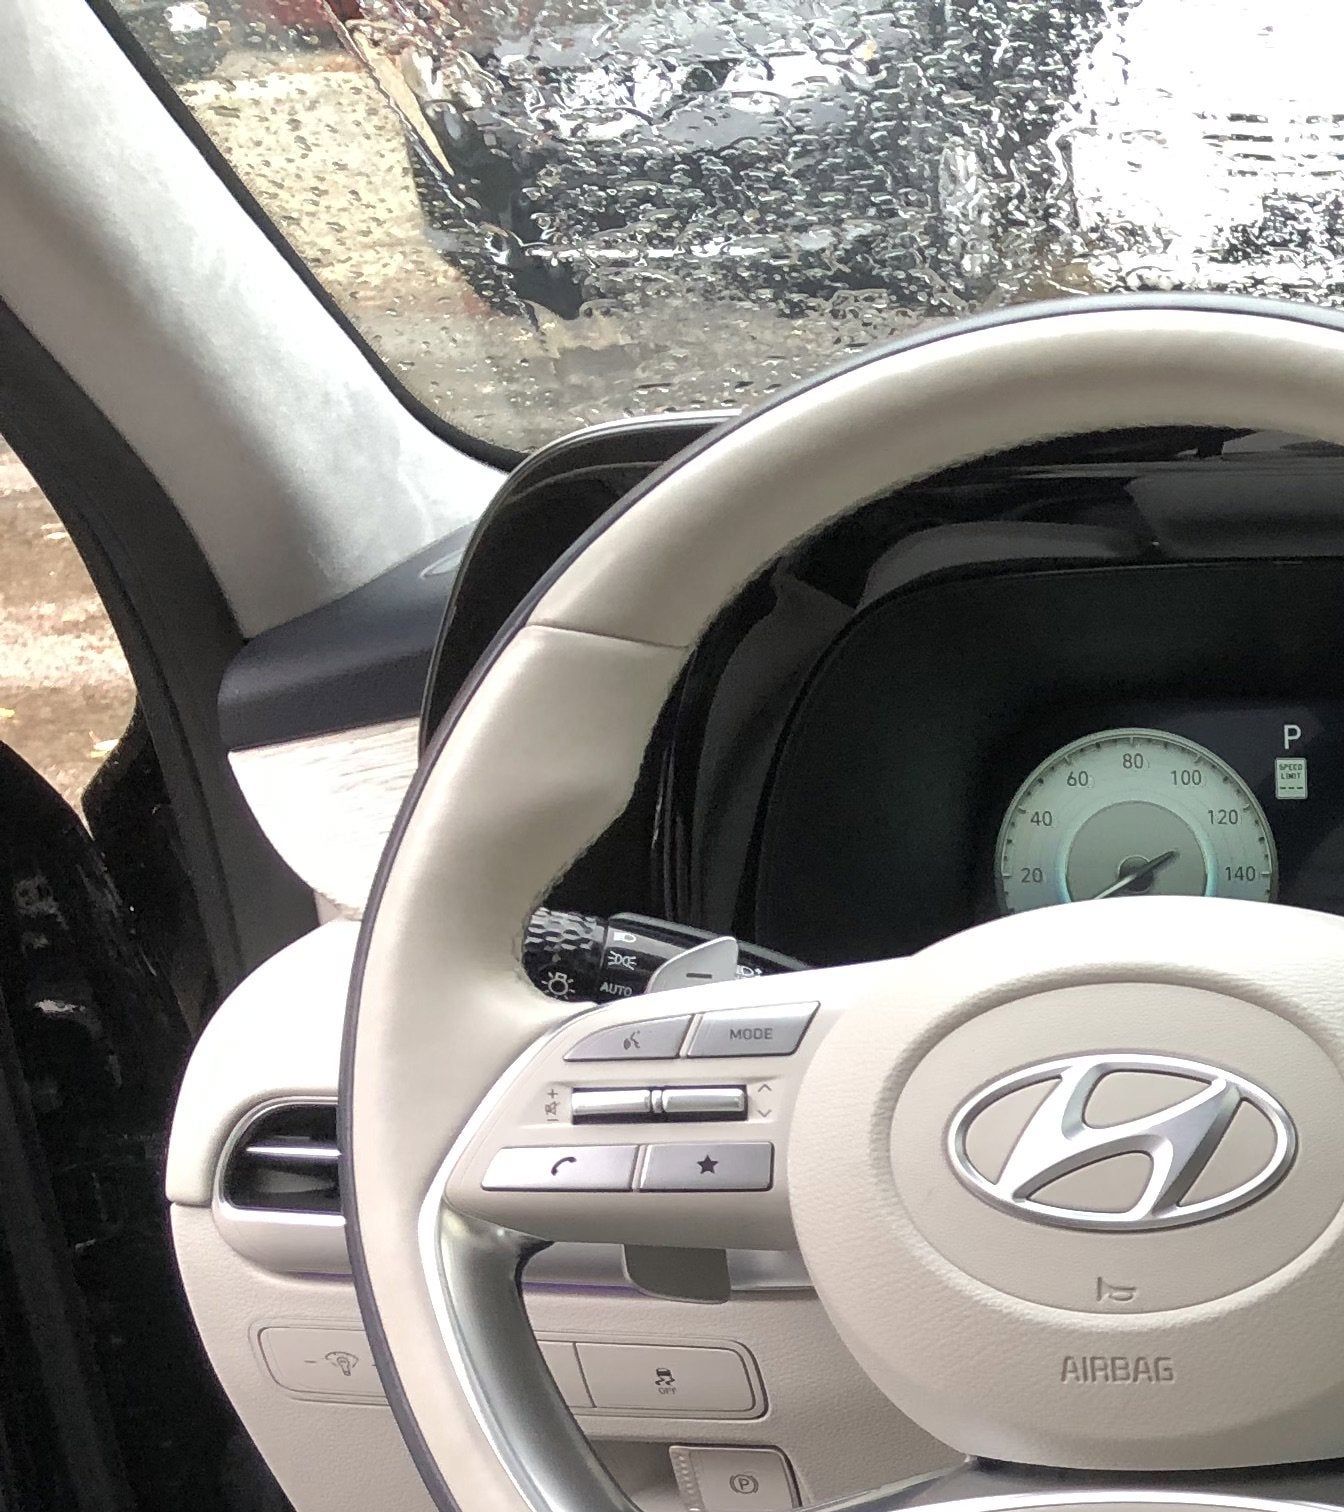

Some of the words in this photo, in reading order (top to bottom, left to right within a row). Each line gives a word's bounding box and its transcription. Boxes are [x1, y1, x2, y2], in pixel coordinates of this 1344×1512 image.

[1283, 724, 1302, 750] P
[1121, 753, 1145, 769] 80
[1066, 770, 1089, 787] 60
[1170, 769, 1202, 786] 100
[1030, 810, 1052, 827] 40
[1208, 809, 1239, 826] 120
[1020, 867, 1043, 883] 20
[1225, 866, 1256, 882] 140
[600, 981, 633, 997] AUTO
[729, 1027, 774, 1041] MODE
[1059, 1355, 1174, 1383] AIRBAG
